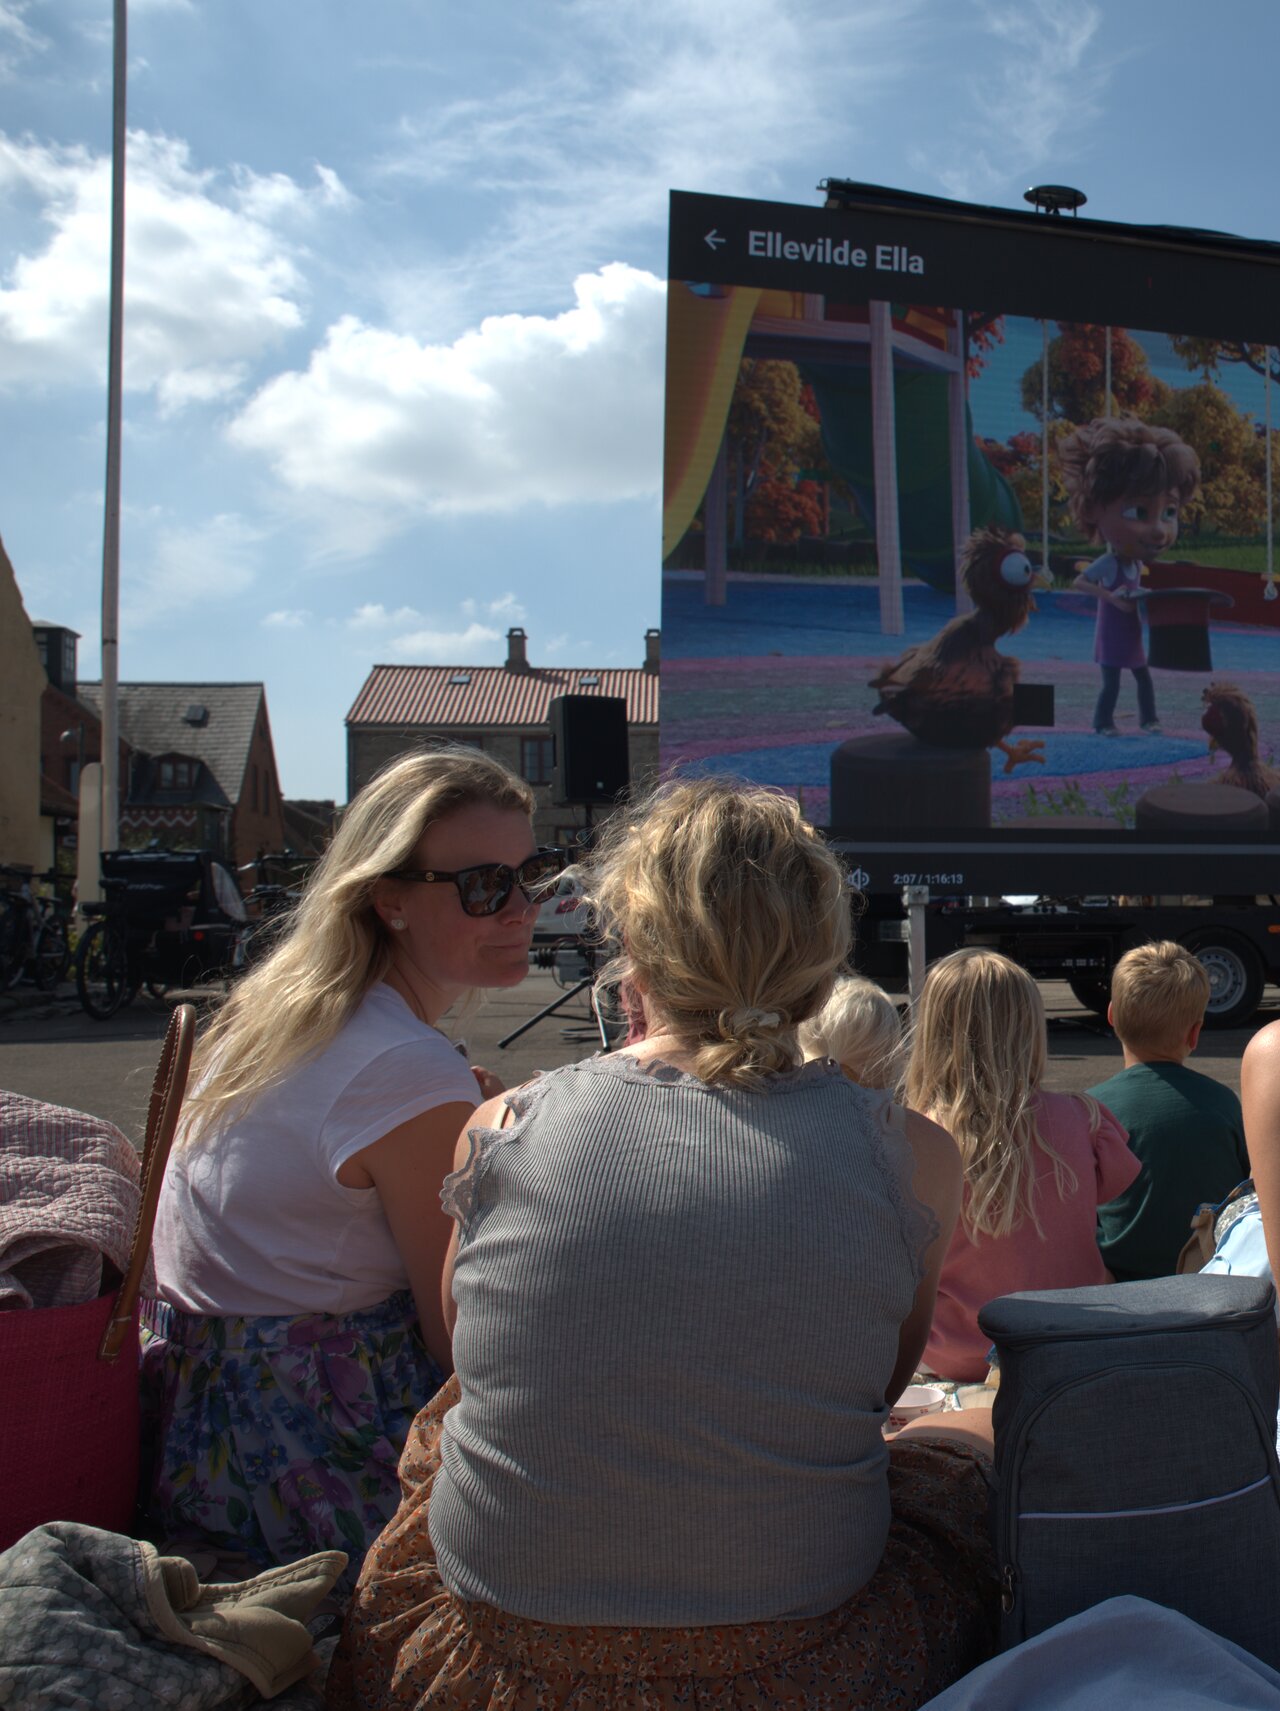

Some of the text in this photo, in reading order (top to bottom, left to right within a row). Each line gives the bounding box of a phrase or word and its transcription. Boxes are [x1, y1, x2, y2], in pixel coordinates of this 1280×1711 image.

[748, 230, 924, 275] Ellevilde Ella
[893, 874, 917, 884] 2:07
[925, 874, 963, 884] 1:16:13
